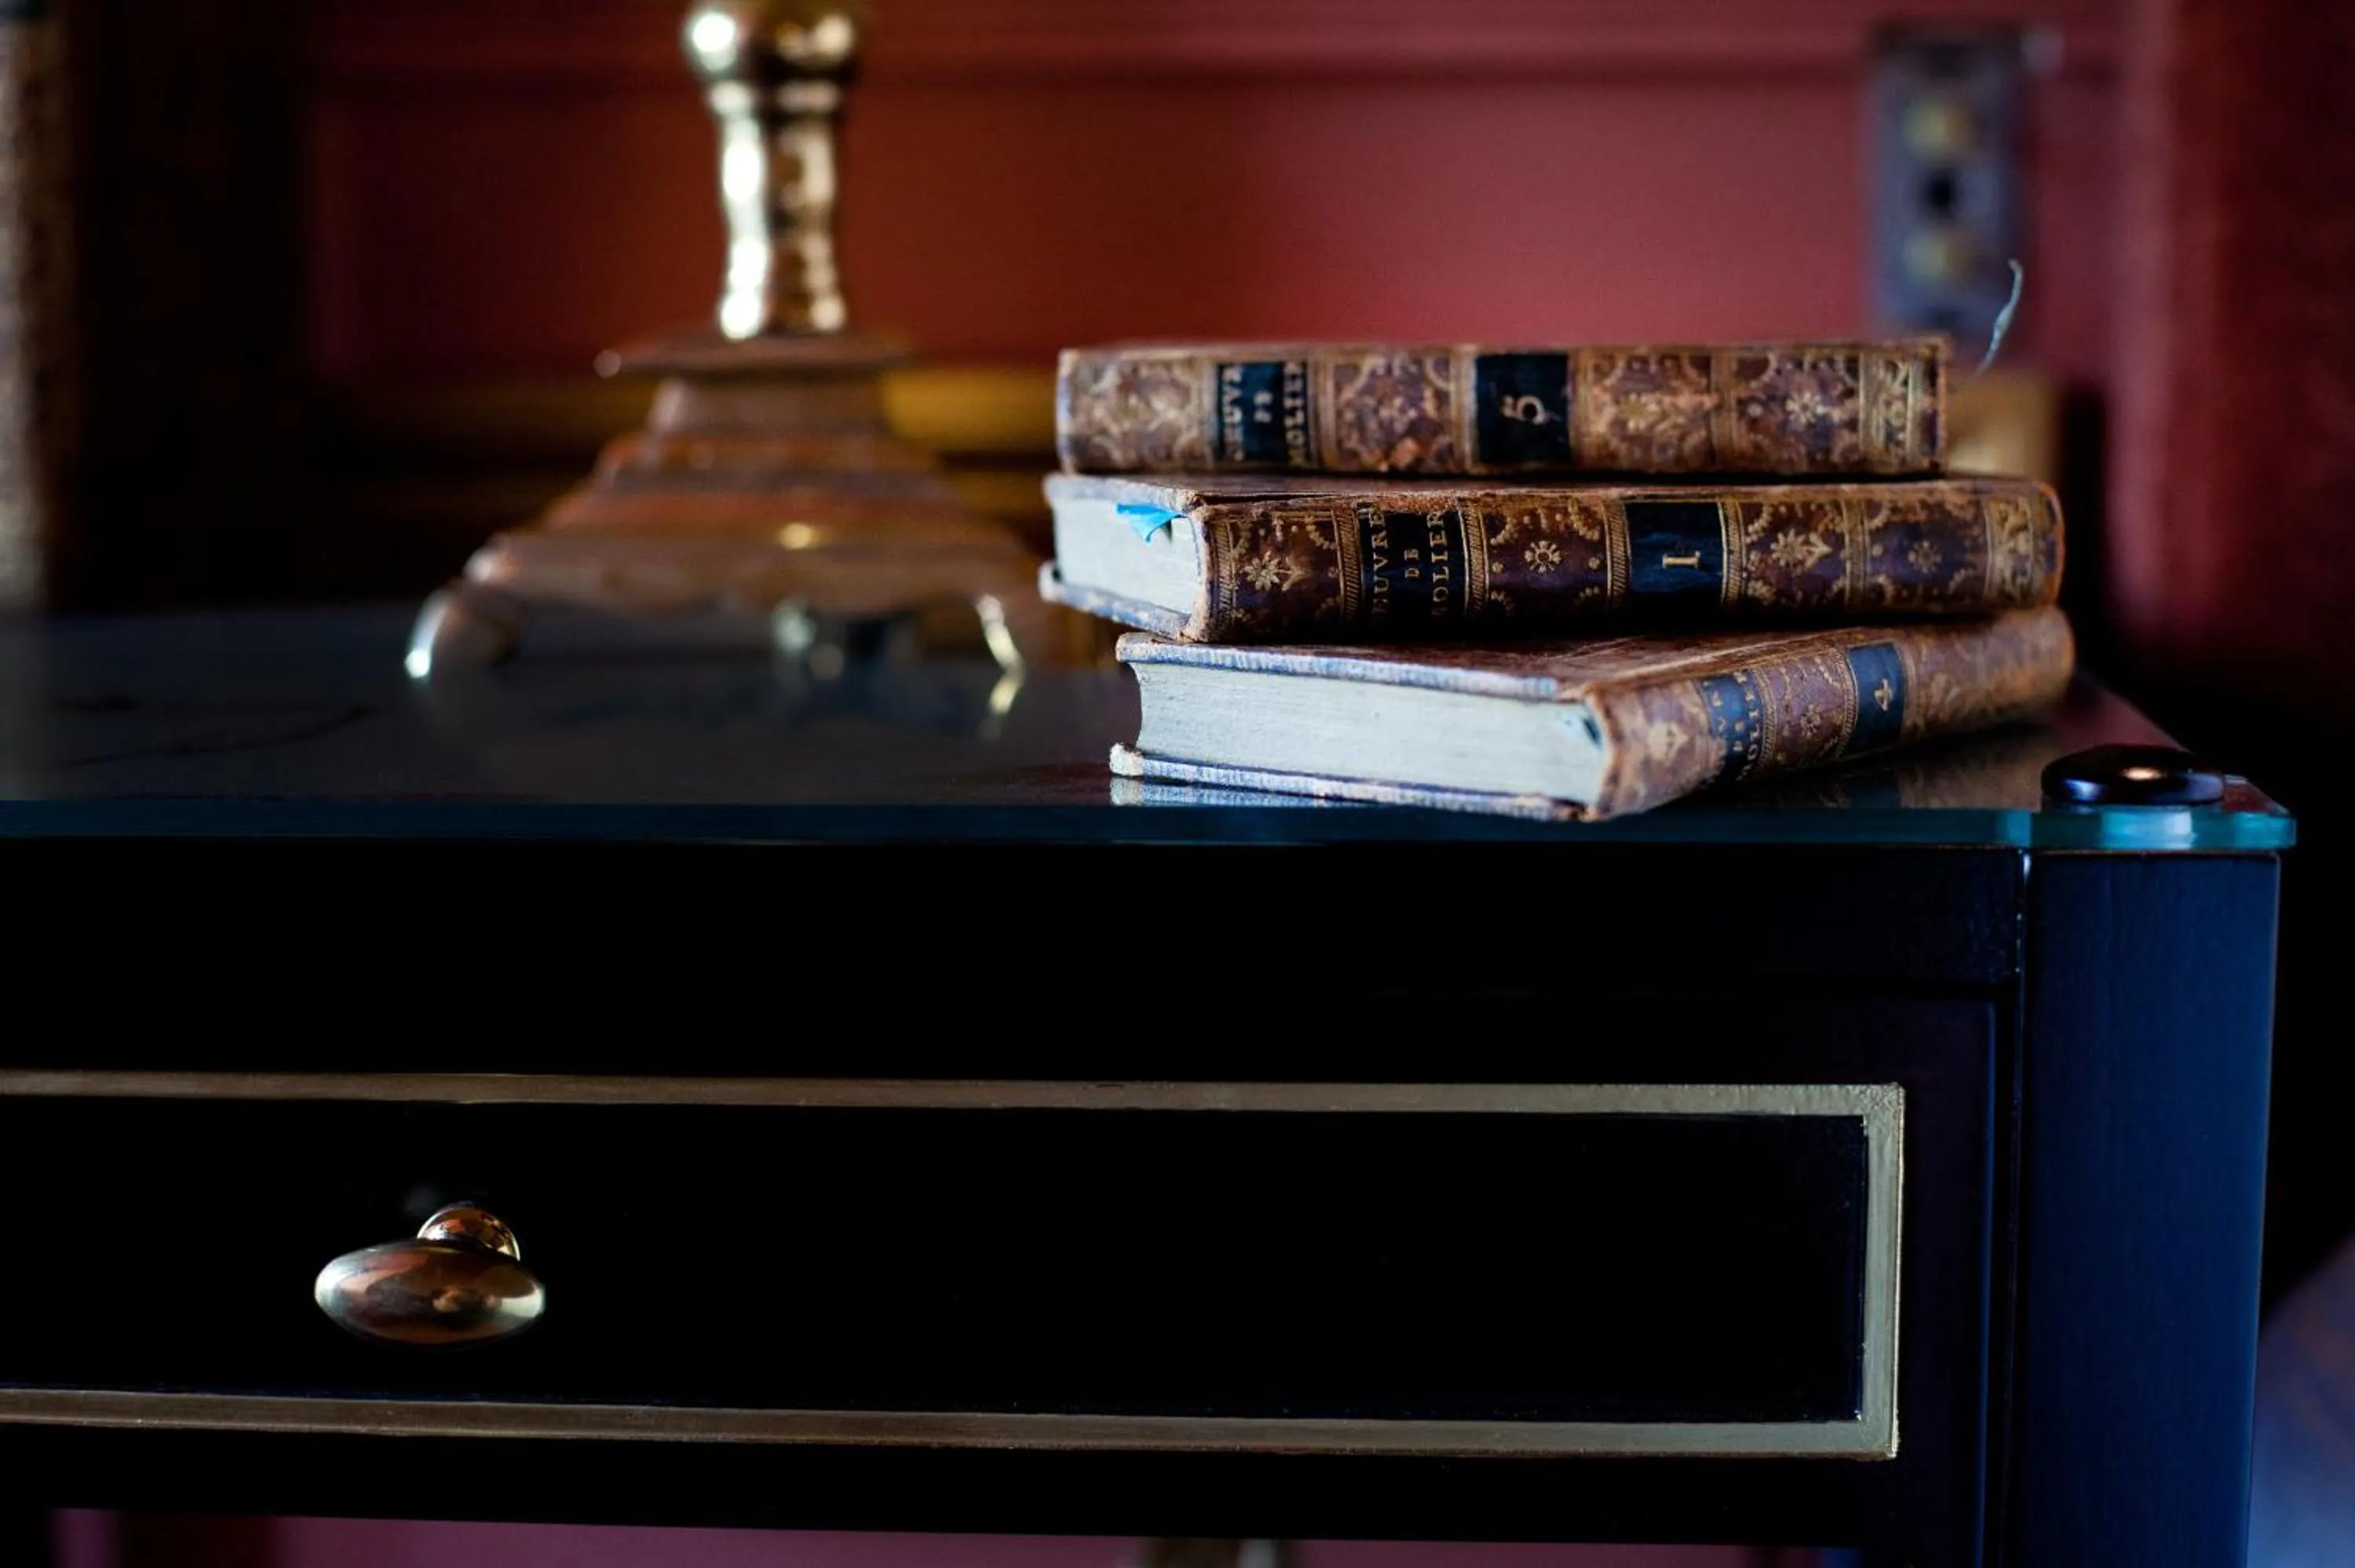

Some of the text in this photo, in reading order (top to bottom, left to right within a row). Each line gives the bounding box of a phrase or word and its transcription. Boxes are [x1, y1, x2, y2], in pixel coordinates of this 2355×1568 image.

[1499, 395, 1550, 425] 5
[1404, 549, 1419, 578] DE
[1874, 678, 1893, 711] 4
